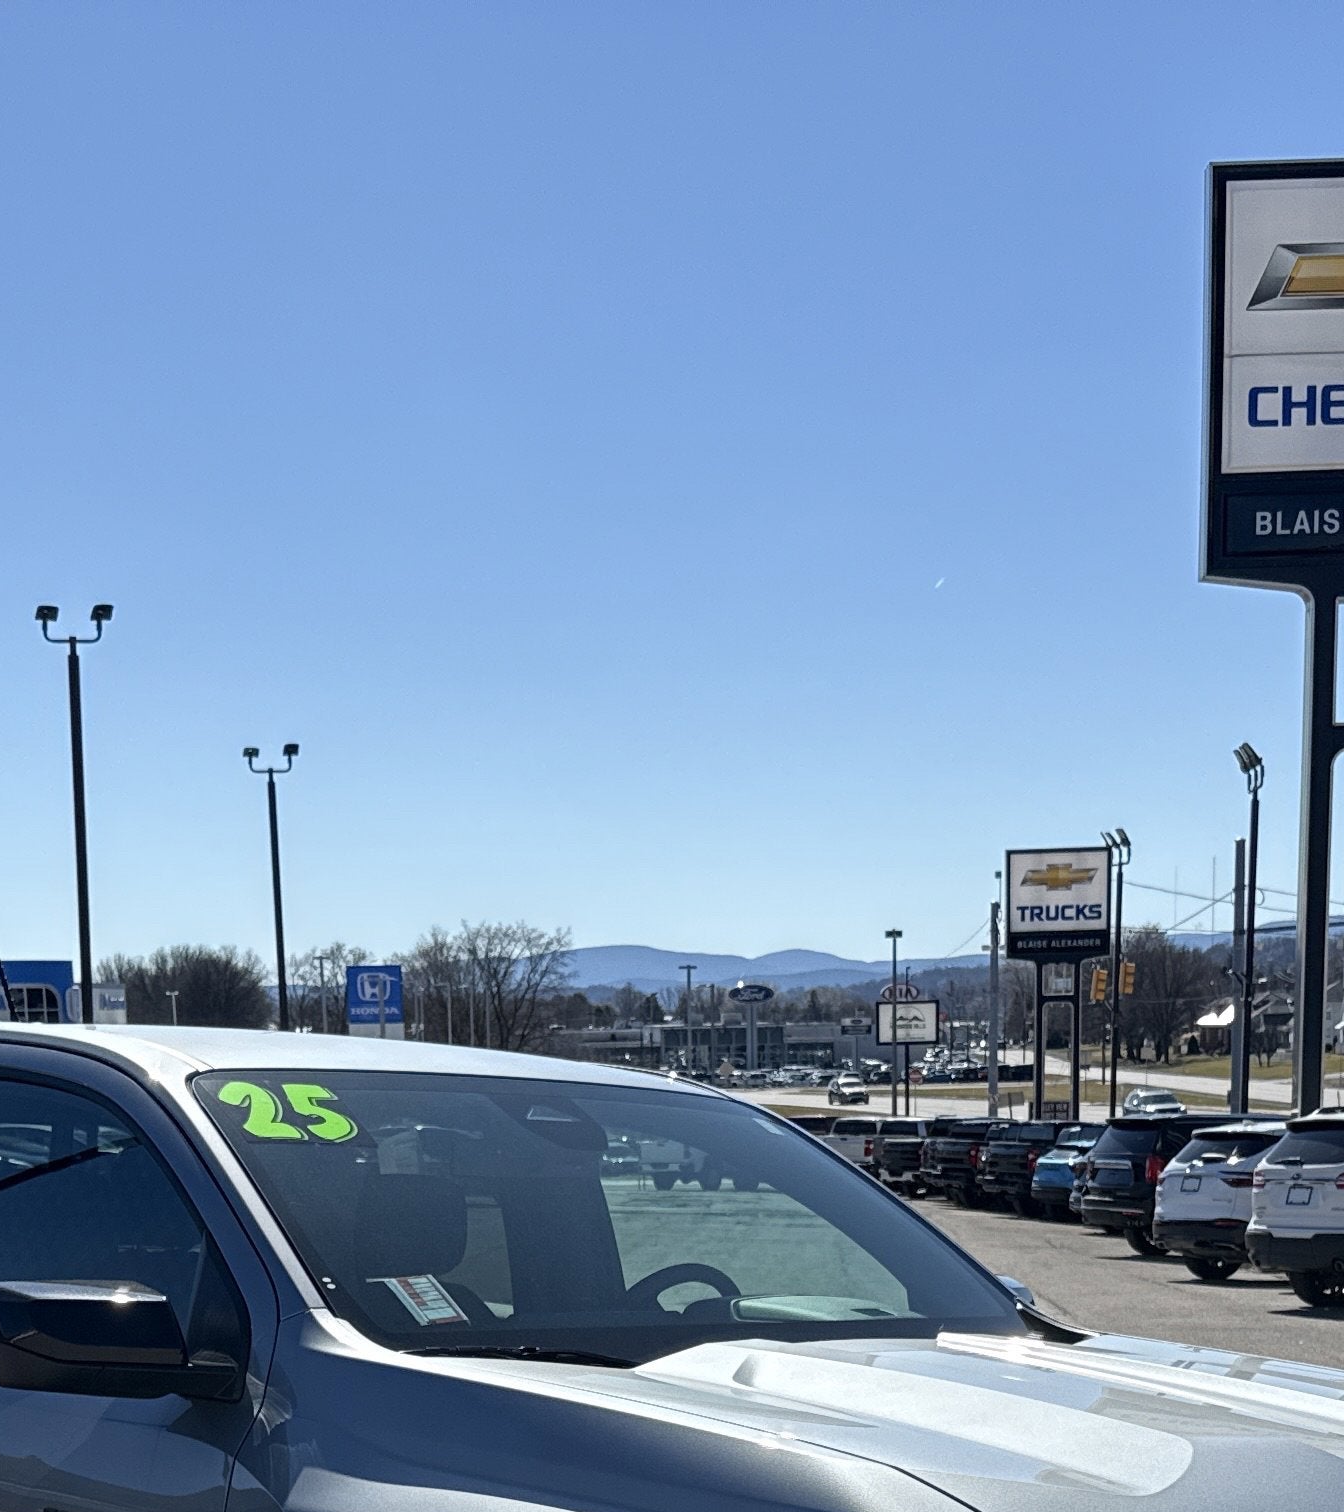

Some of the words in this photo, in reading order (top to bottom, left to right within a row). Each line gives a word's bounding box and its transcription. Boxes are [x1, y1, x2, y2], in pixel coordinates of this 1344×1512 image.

[1016, 903, 1103, 923] TRUCKS
[1017, 939, 1048, 949] BLAISE
[1051, 937, 1102, 948] ALEXANDER
[736, 988, 766, 1001] Ford
[350, 1006, 400, 1016] HONDA
[217, 1081, 358, 1143] 25
